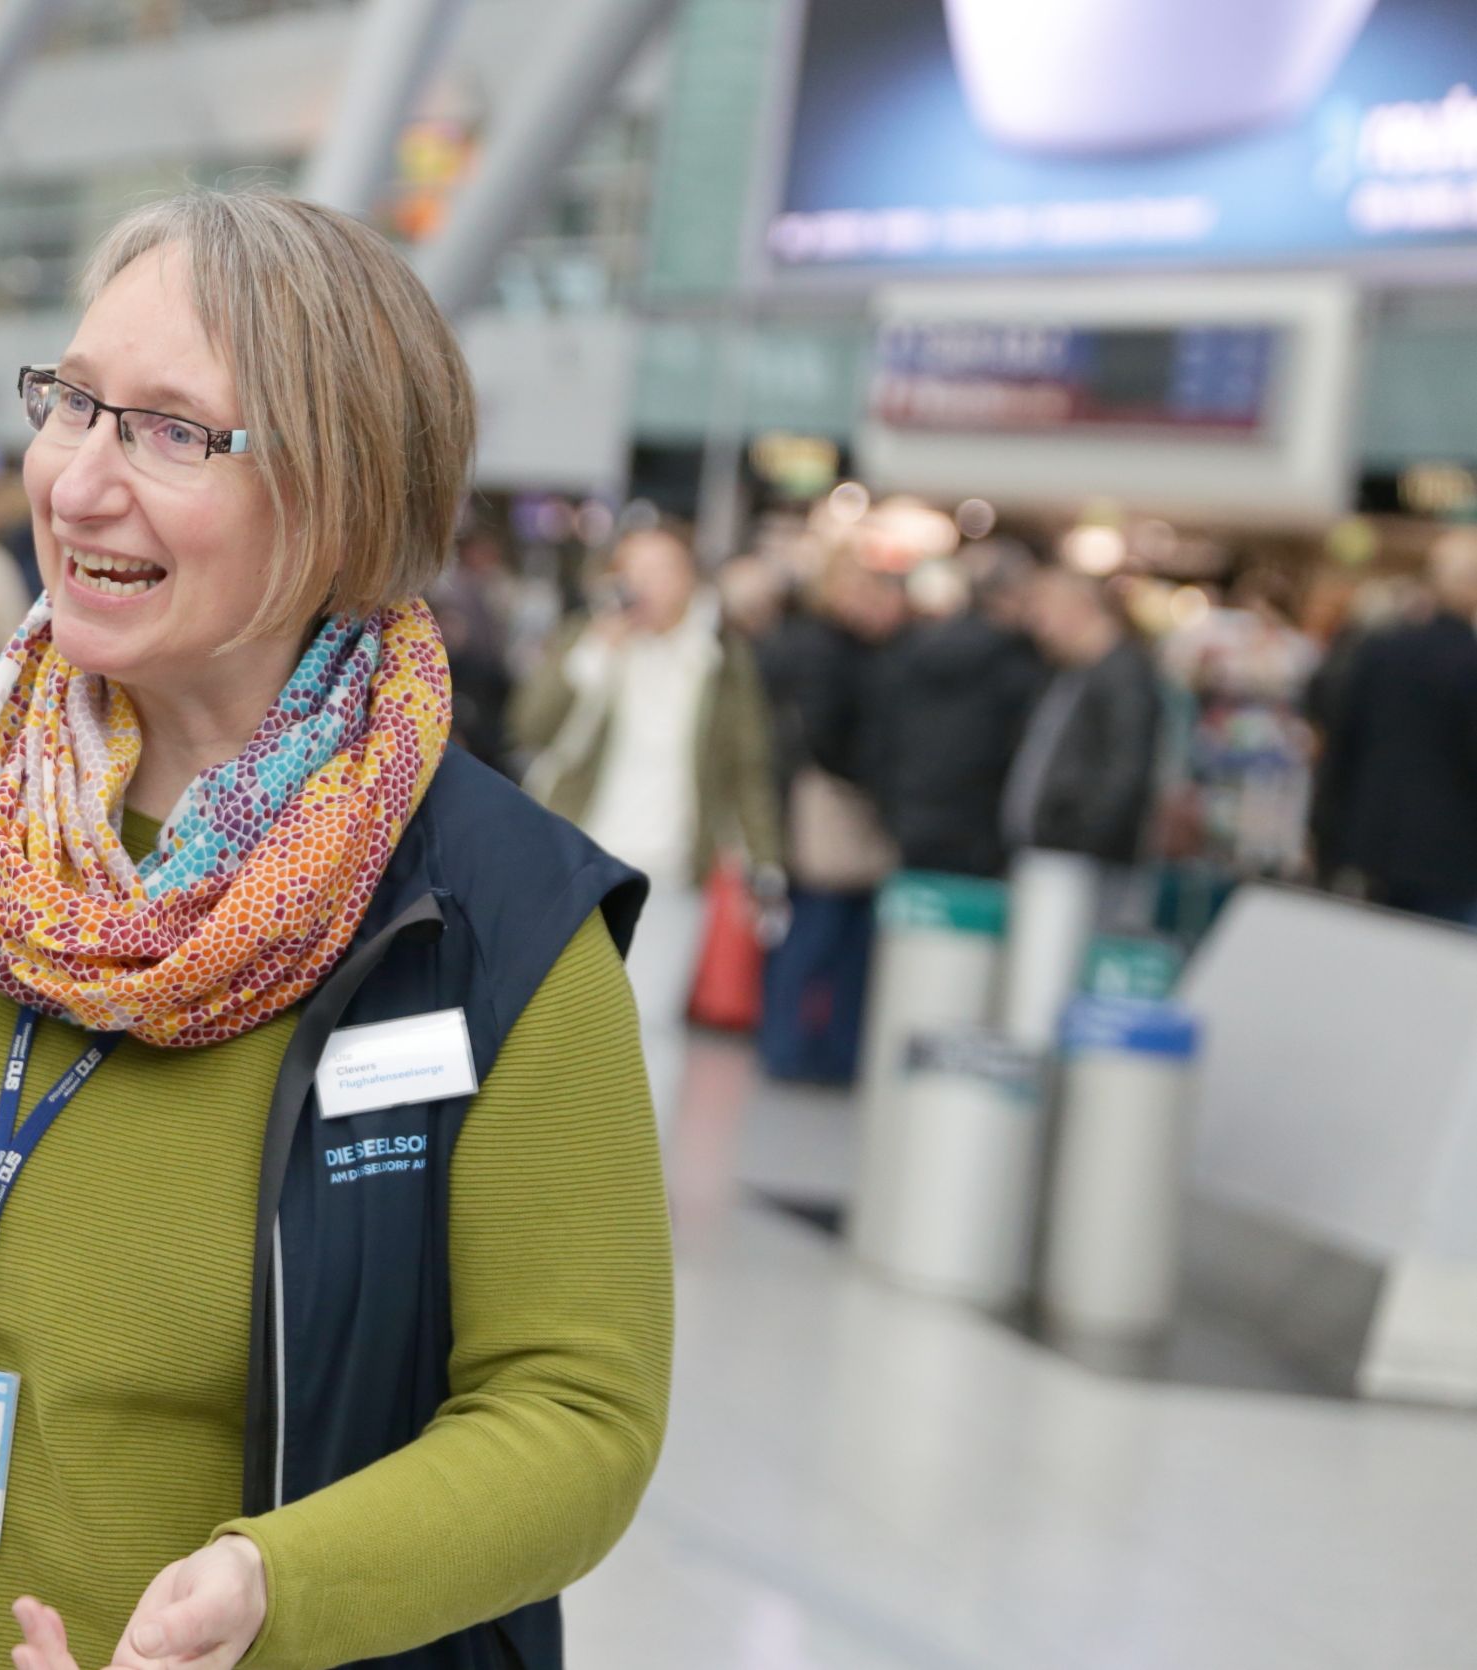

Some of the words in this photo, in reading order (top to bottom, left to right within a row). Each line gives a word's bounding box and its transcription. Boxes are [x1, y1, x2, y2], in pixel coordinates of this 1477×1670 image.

[74, 1048, 102, 1078] DUS
[336, 1062, 376, 1076] Clevers
[4, 1060, 24, 1091] DUS
[326, 1145, 356, 1167] DIE
[330, 1170, 348, 1184] AM
